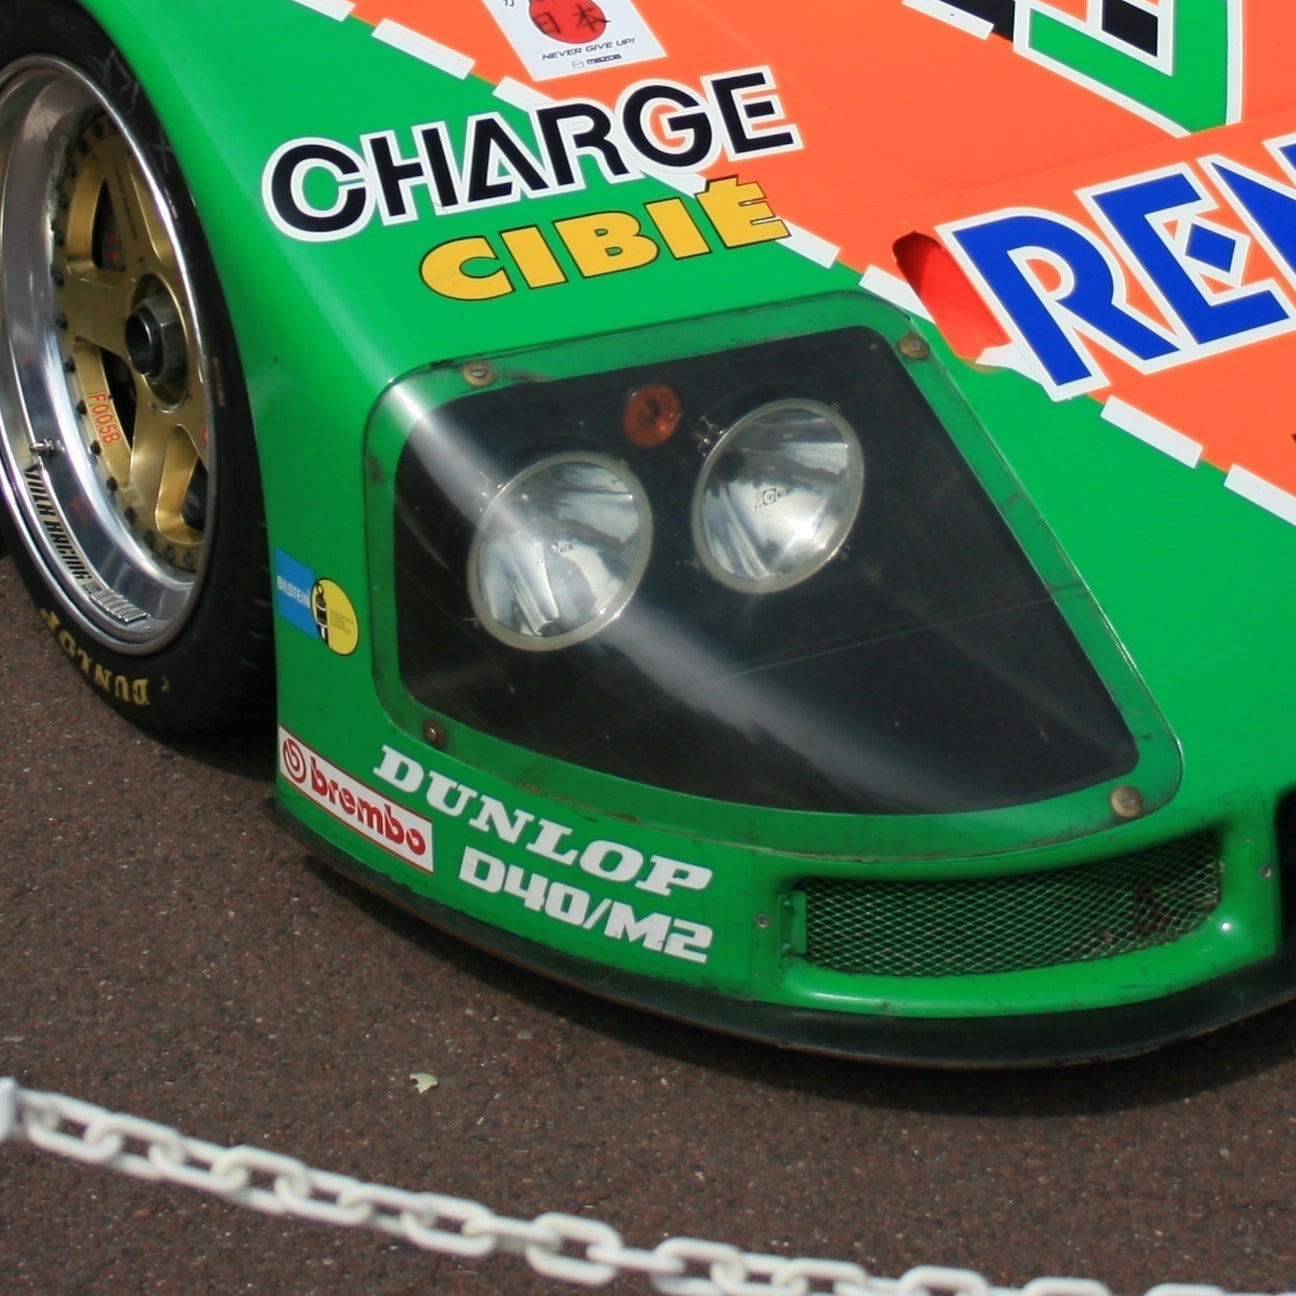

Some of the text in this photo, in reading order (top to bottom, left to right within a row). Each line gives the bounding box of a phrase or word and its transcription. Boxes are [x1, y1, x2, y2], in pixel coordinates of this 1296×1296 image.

[533, 3, 612, 36] 日本
[541, 45, 583, 61] NEVER
[585, 40, 613, 54] GIVE
[262, 67, 804, 242] CHARGE
[310, 758, 426, 856] brembo
[373, 744, 713, 897] DUNLOP
[459, 846, 713, 963] D40/M2
